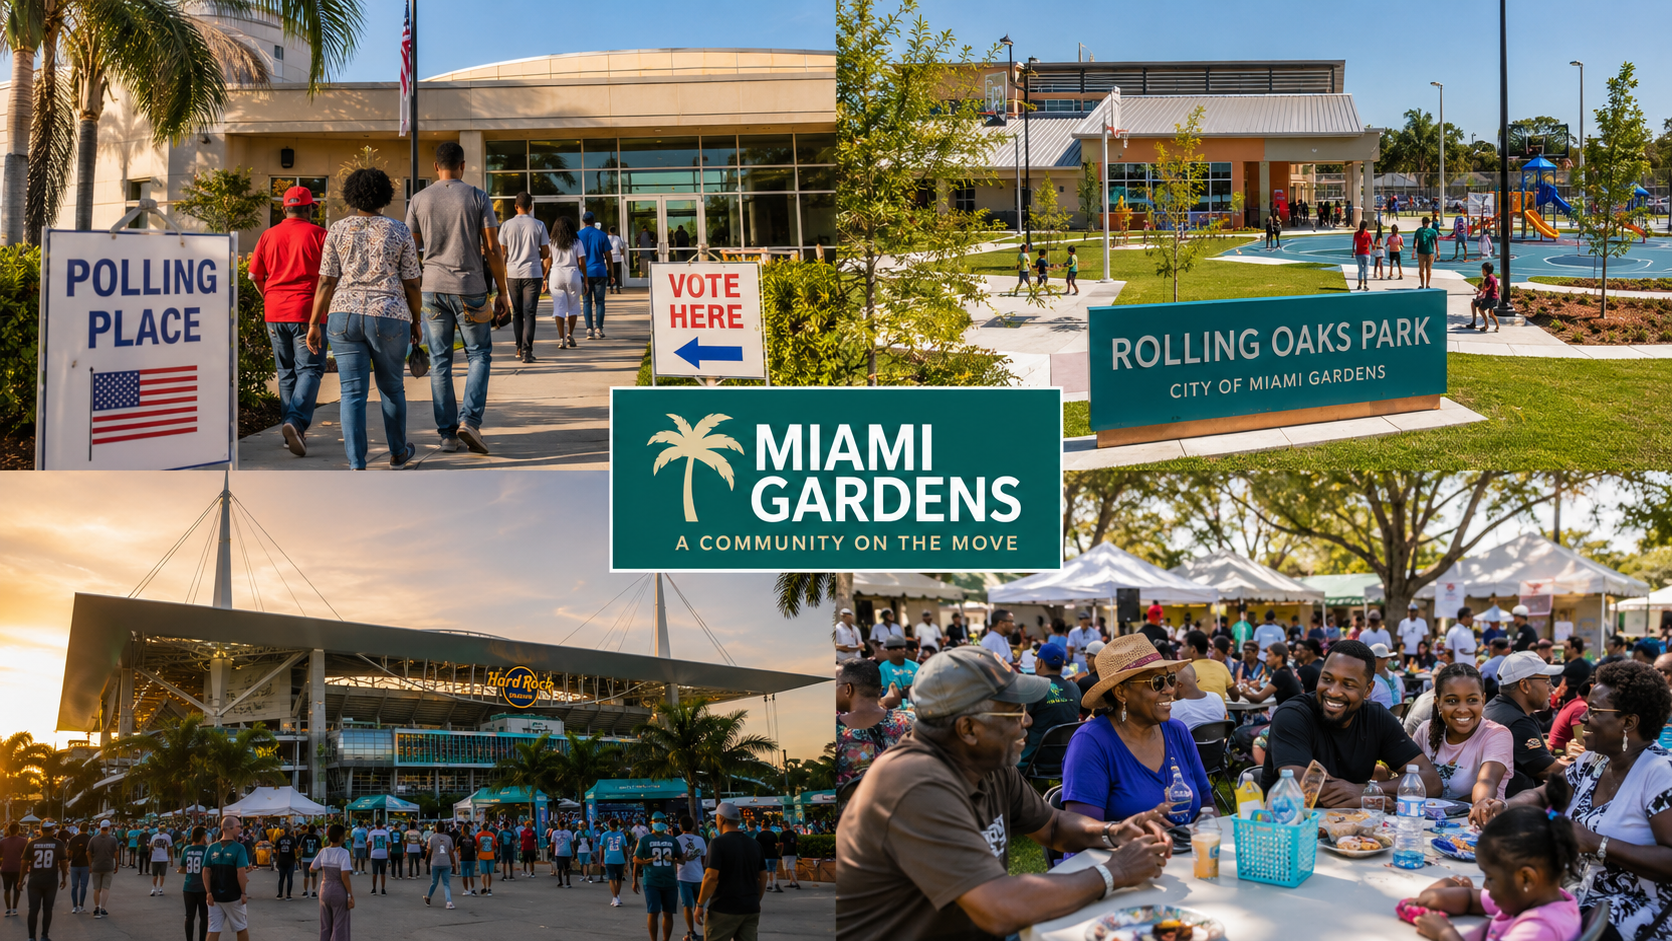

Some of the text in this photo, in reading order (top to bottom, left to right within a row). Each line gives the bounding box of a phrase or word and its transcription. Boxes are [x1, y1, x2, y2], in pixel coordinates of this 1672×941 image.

[66, 258, 217, 297] POLLING
[668, 273, 741, 298] VOTE
[88, 307, 201, 349] PLACE
[669, 304, 744, 329] HERE
[1111, 316, 1431, 370] ROLLING OAKS PARK
[1169, 365, 1386, 399] CITY OF MIAMI GARDENS
[487, 671, 555, 695] Hard Rock
[33, 849, 54, 868] 28
